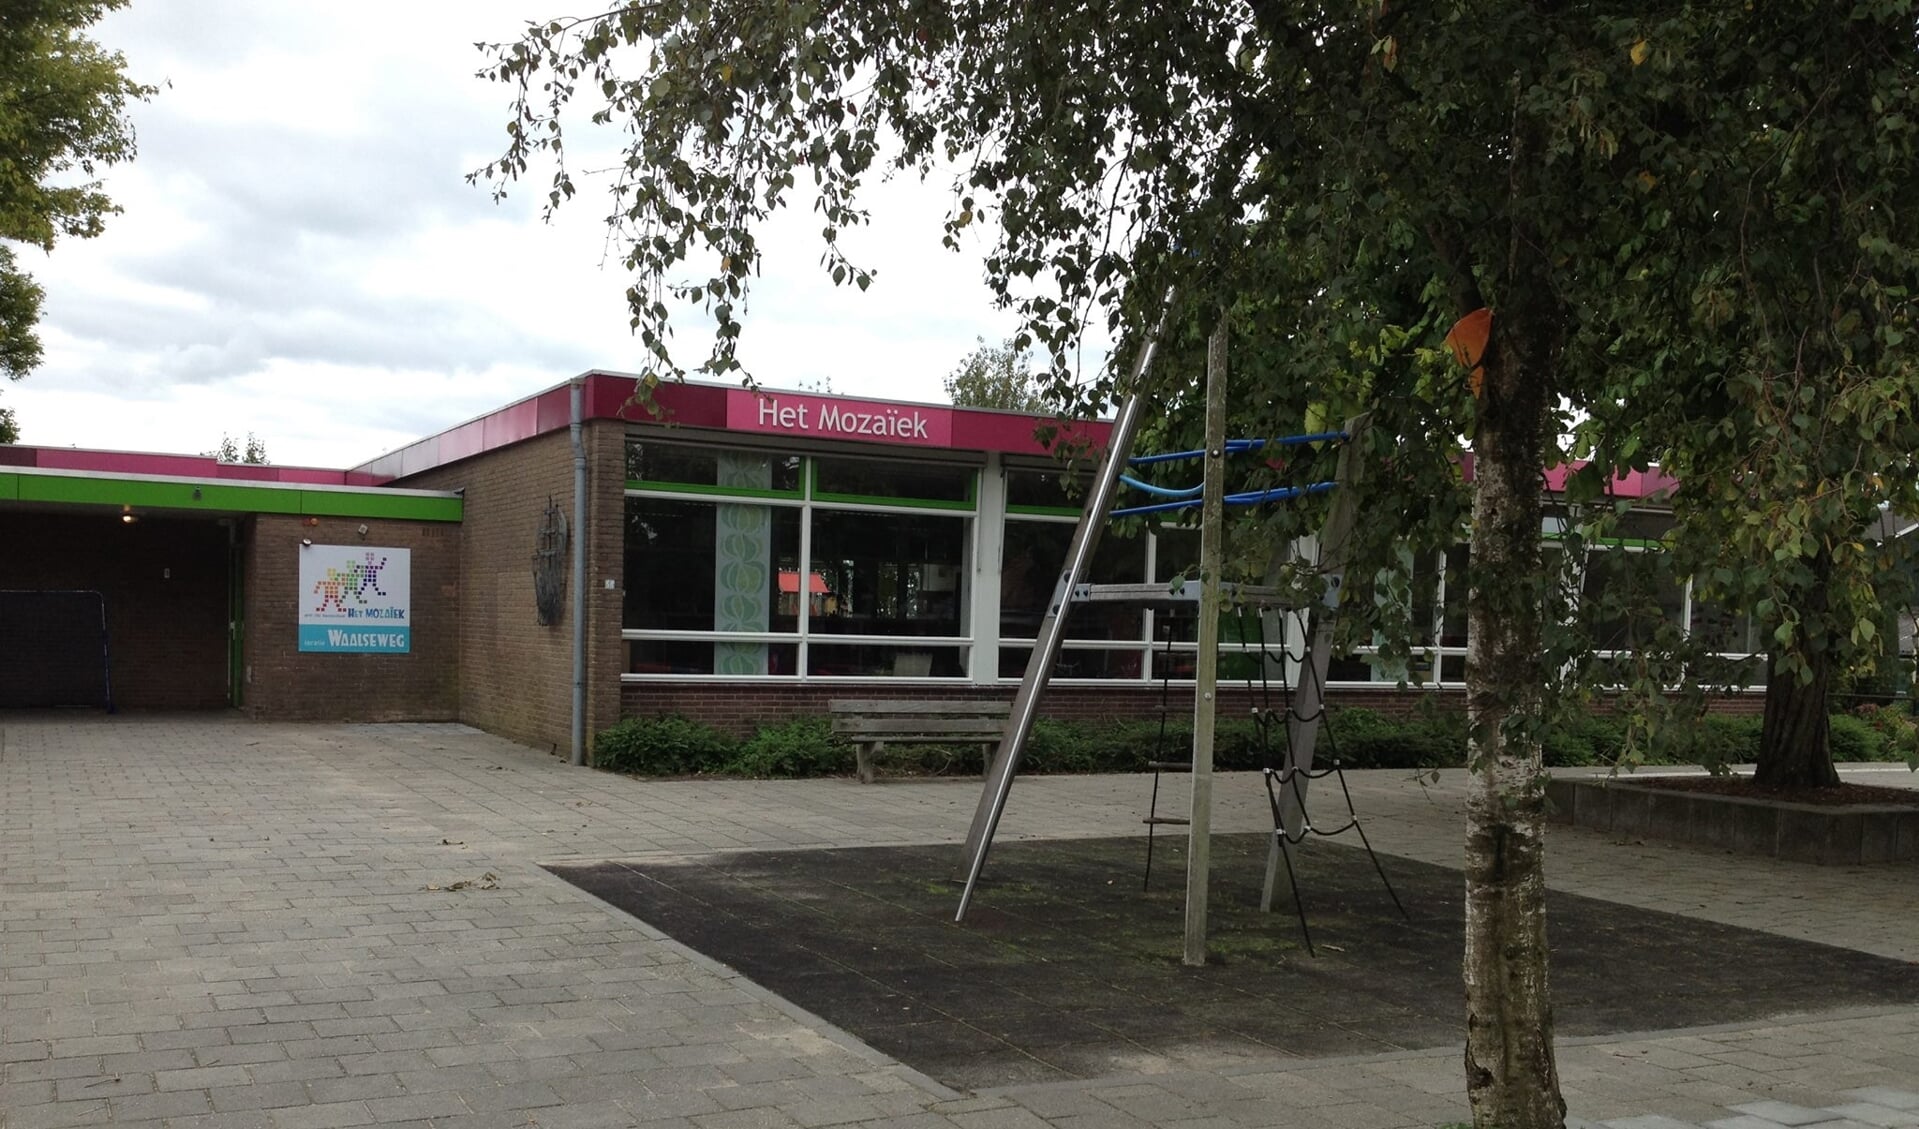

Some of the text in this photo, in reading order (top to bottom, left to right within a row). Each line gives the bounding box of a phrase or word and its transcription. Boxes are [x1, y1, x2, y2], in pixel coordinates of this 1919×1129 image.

[759, 398, 928, 439] Het Mozaïek
[328, 629, 405, 648] WAALSEWEG
